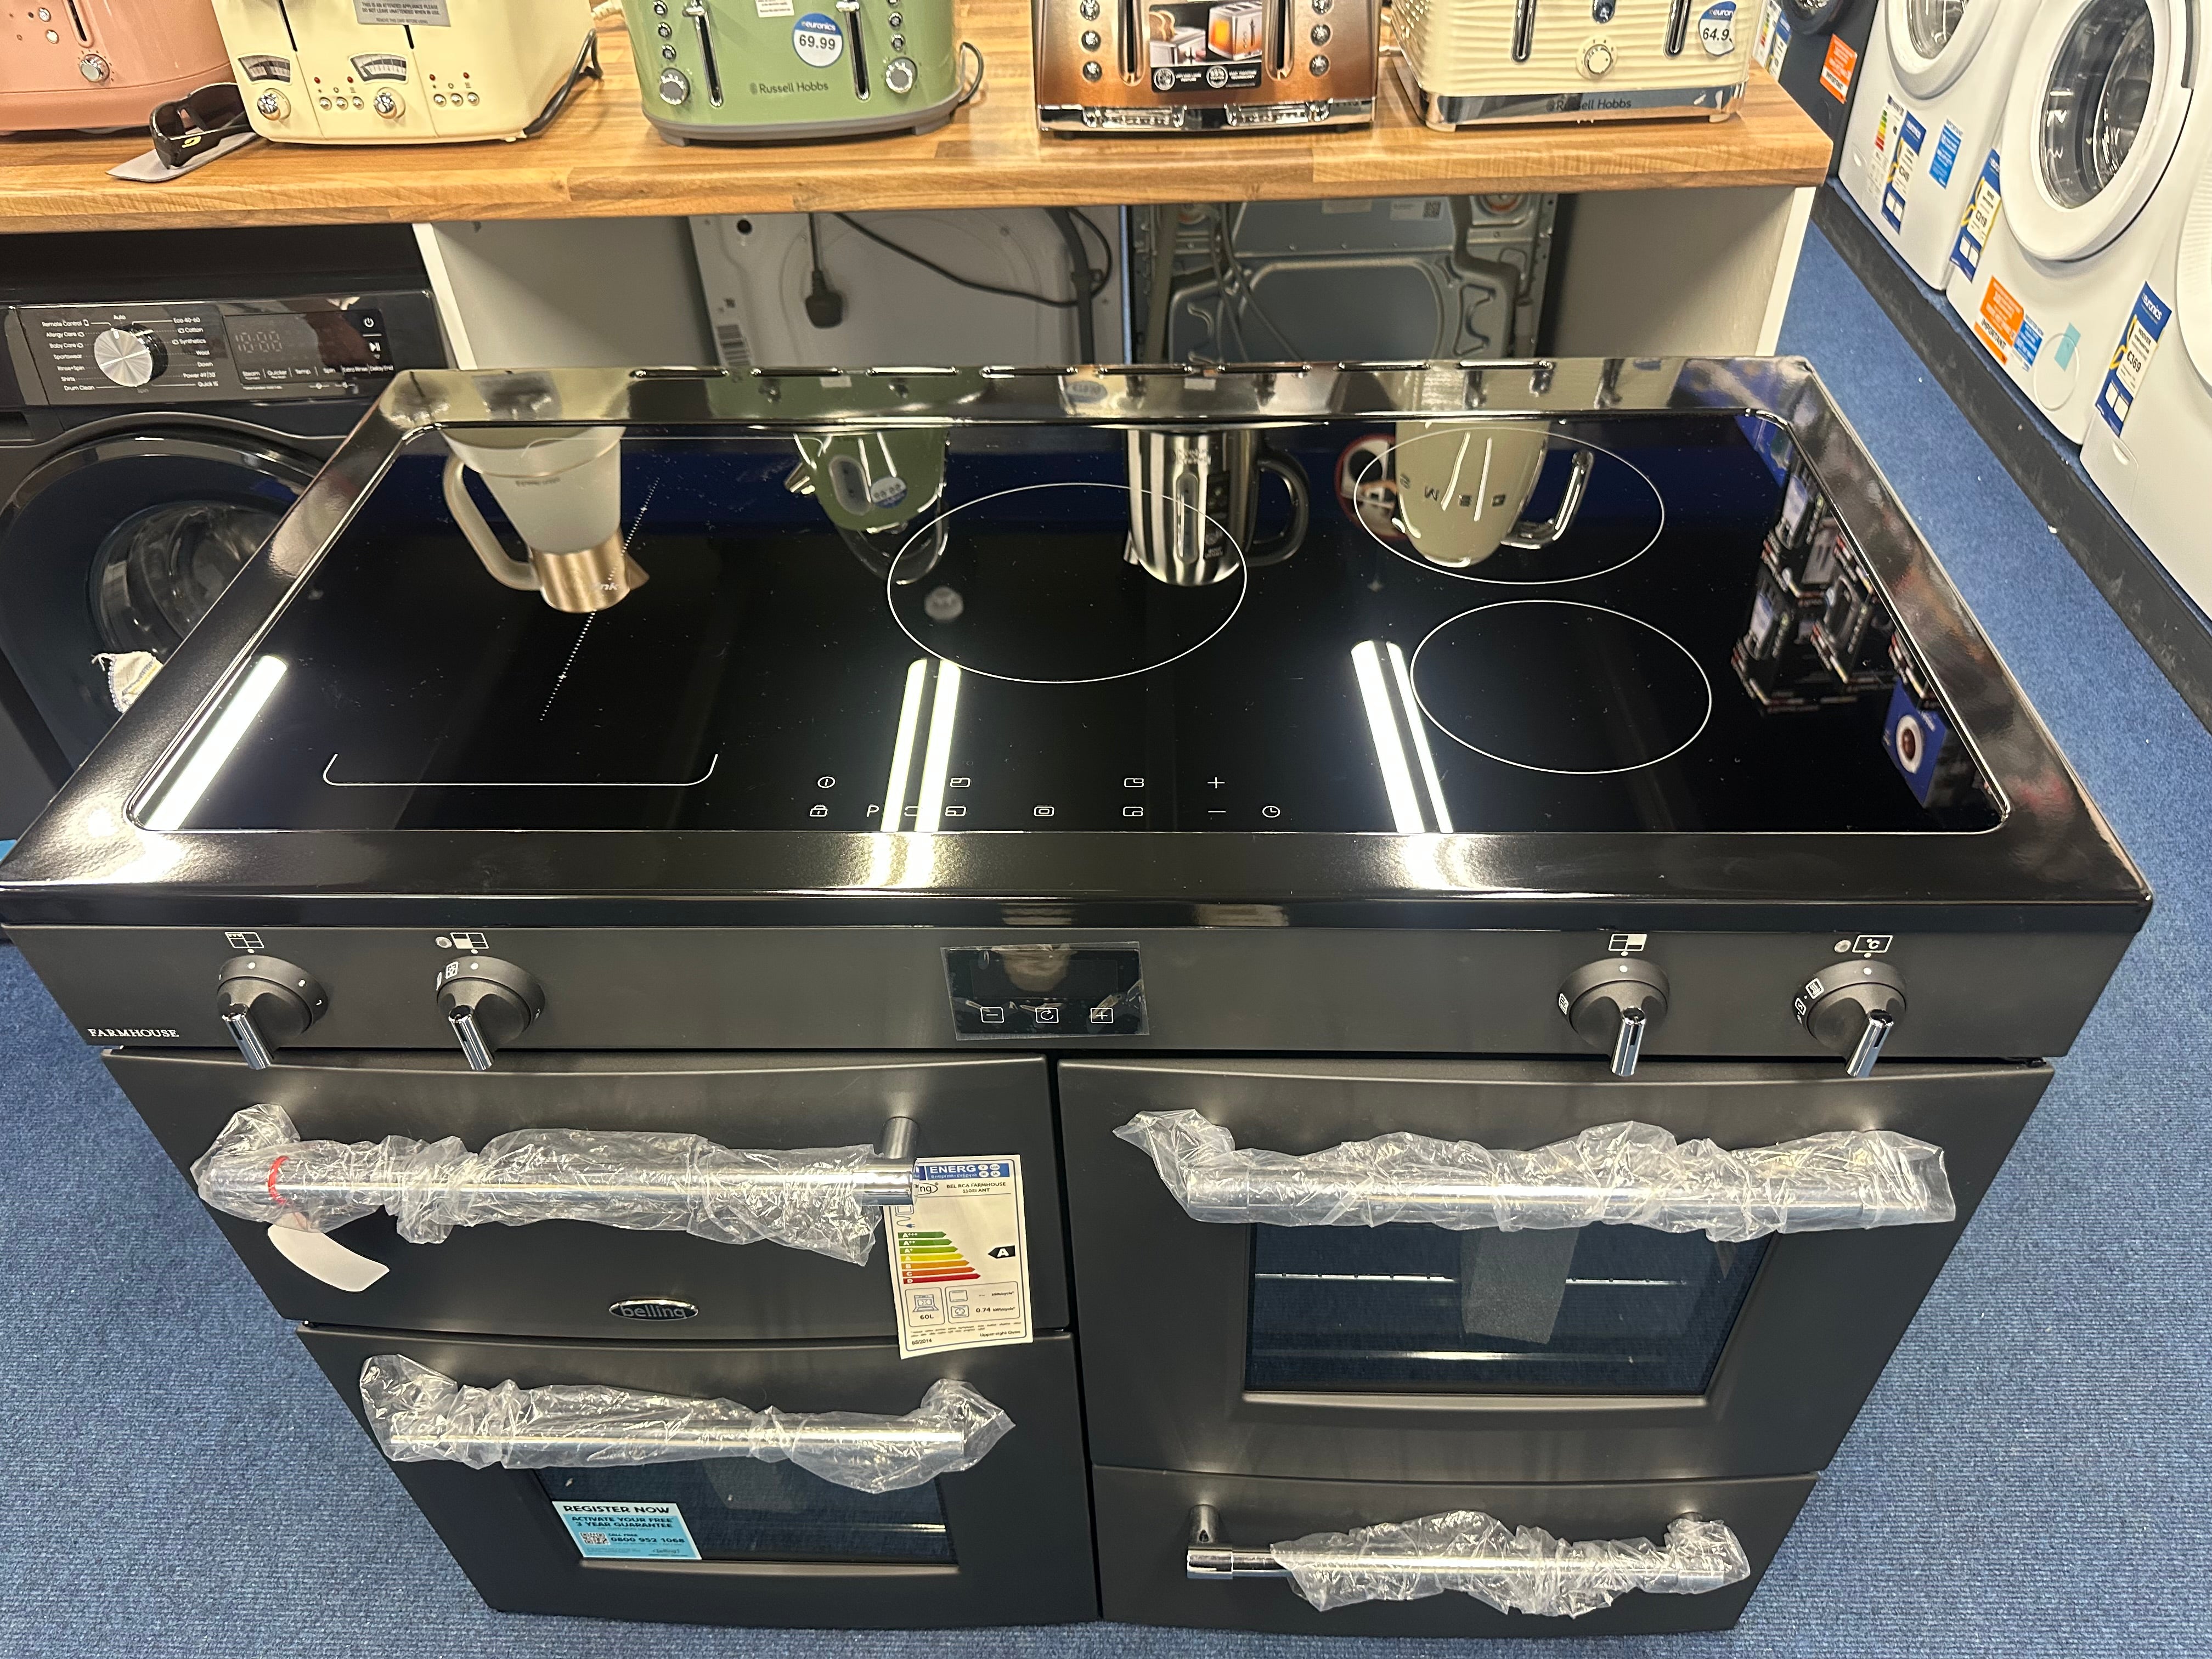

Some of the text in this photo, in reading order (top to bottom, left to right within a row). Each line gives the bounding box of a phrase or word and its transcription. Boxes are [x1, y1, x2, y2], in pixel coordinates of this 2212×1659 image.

[1703, 27, 1732, 43] 64.9
[799, 34, 836, 50] 69.99
[759, 81, 828, 94] Russell Hobbs
[1556, 98, 1632, 110] Rell Hobbs
[2141, 293, 2162, 320] euronics
[2127, 351, 2141, 373] €369
[867, 805, 879, 817] P
[87, 1029, 179, 1037] FARMHOUSE
[930, 1165, 976, 1174] ENERG
[997, 1248, 1009, 1257] A
[620, 1304, 686, 1318] belling
